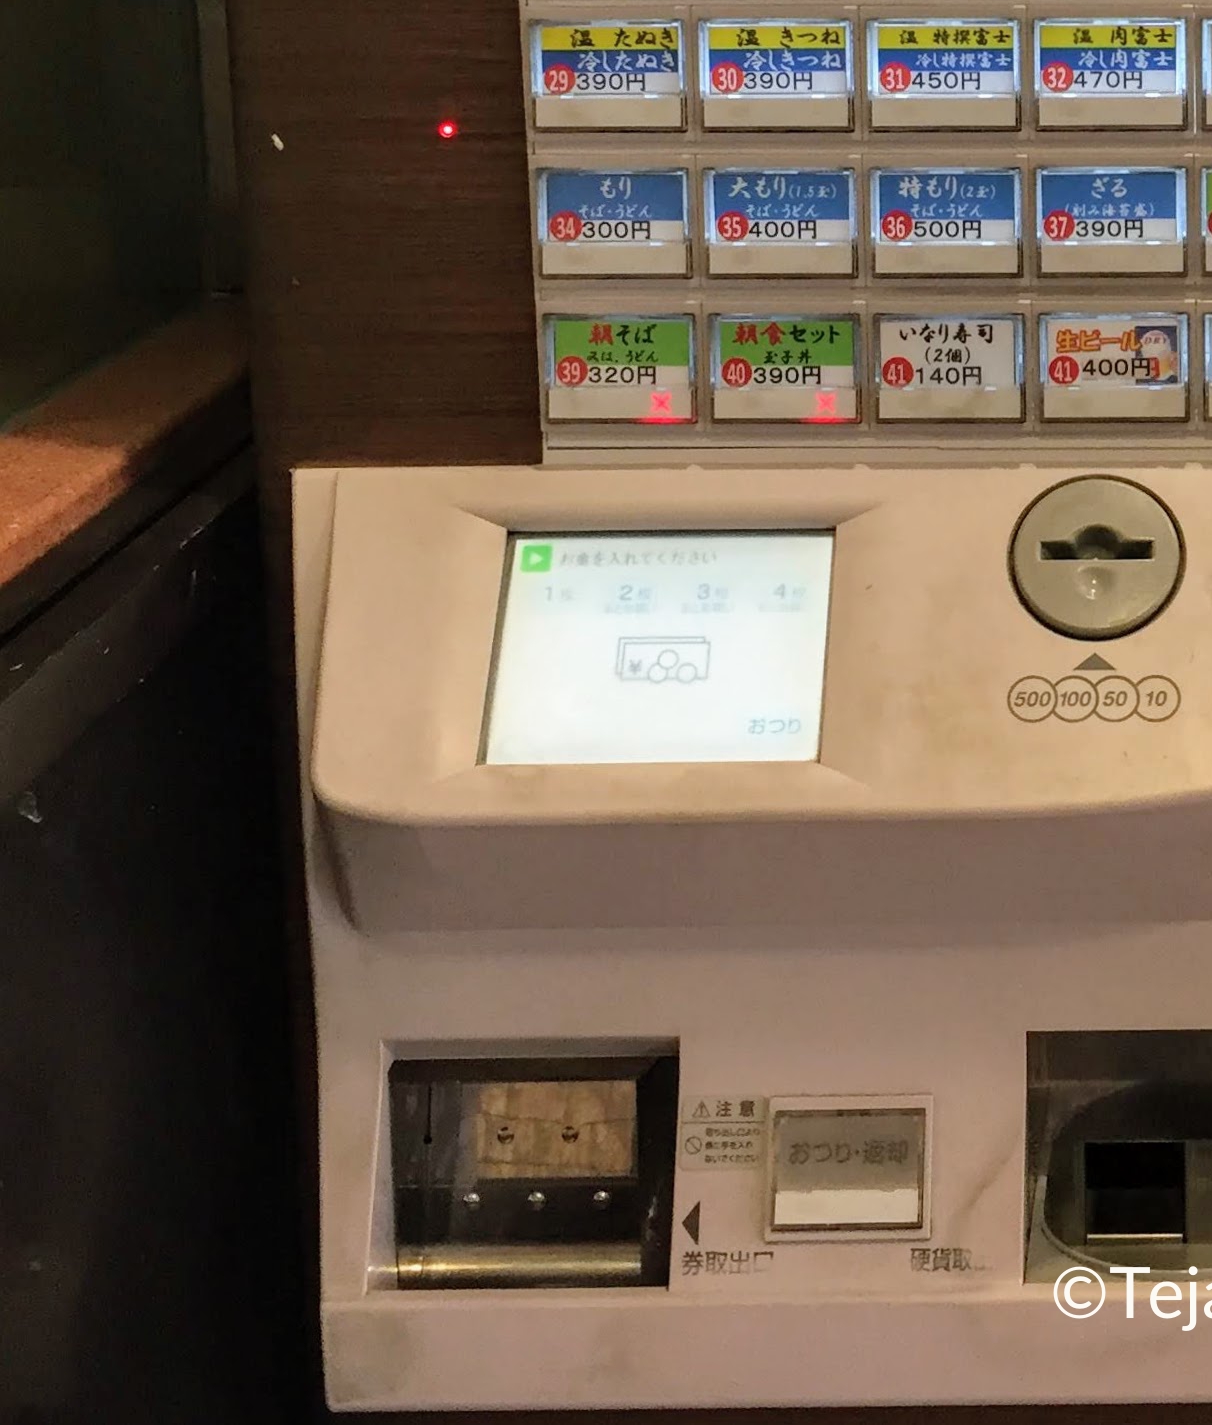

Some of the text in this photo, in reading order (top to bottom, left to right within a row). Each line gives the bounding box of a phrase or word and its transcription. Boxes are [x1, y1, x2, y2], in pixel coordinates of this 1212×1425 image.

[614, 29, 675, 49] たぬき
[780, 28, 840, 48] きつね
[578, 51, 676, 72] 冷したぬき
[744, 51, 842, 71] 冷しきつね
[576, 72, 646, 91] 390円
[744, 71, 813, 91] 390円
[912, 71, 981, 91] 450円
[1074, 70, 1143, 89] 470円
[600, 177, 632, 199] もり
[582, 220, 651, 239] 300円
[749, 220, 817, 240] 400円
[914, 220, 982, 239] 500円
[1076, 219, 1144, 238] 390円
[900, 323, 993, 344] いなり寿司
[1056, 330, 1142, 353] 生ビール
[588, 366, 656, 385] 320円
[754, 366, 822, 385] 390円
[915, 366, 982, 386] 140円
[1082, 358, 1150, 377] 400円
[1014, 691, 1167, 707] 500 100 50 10
